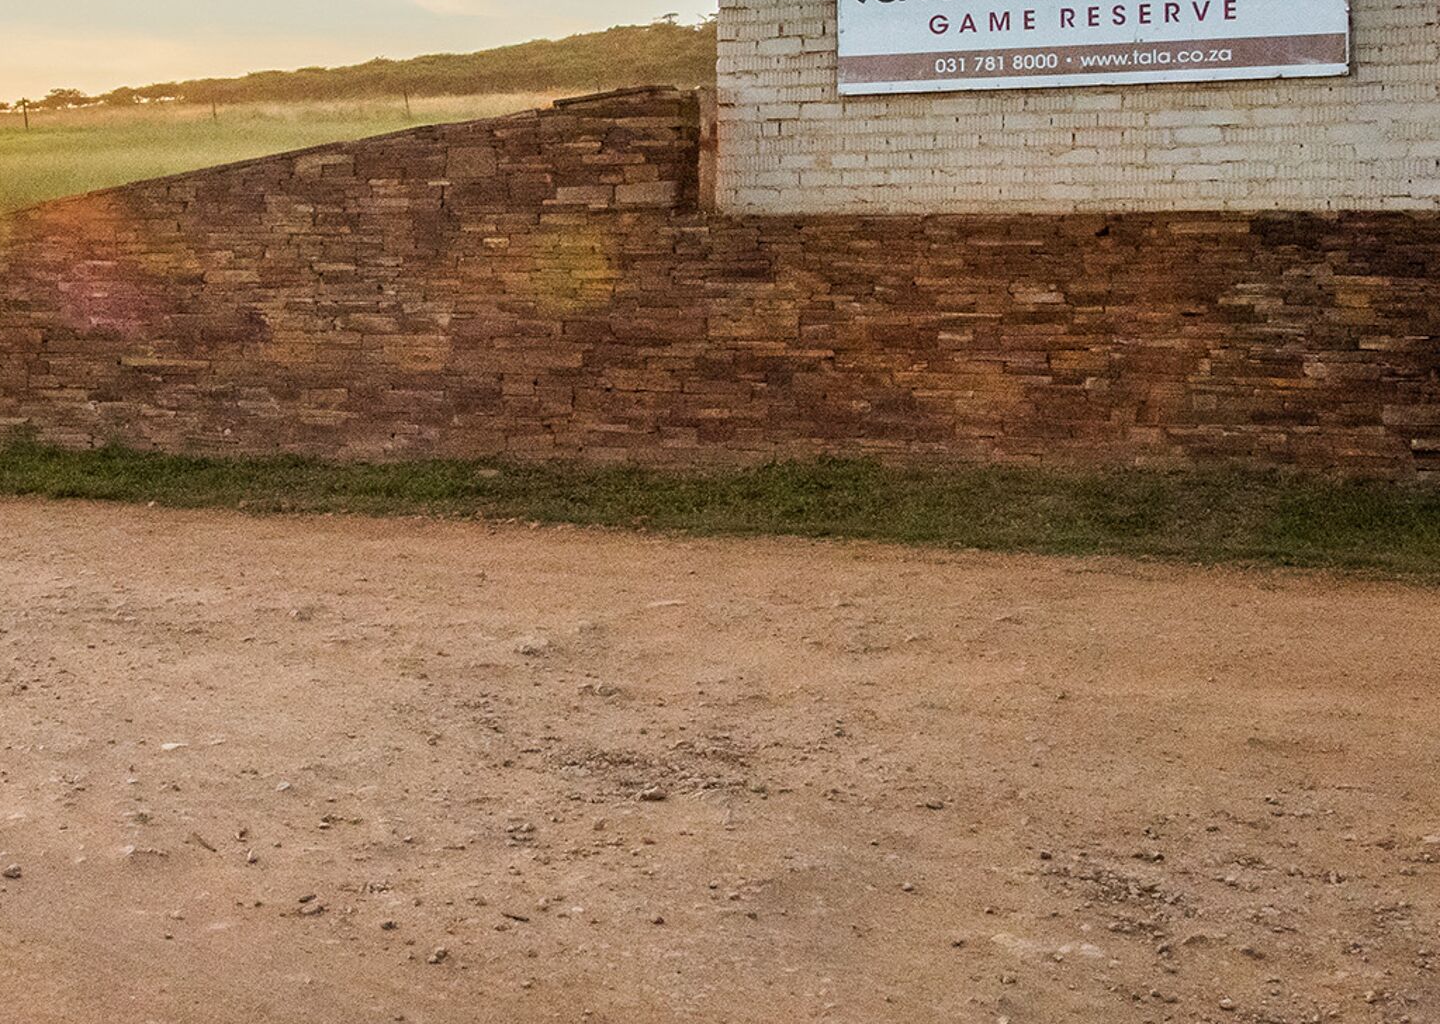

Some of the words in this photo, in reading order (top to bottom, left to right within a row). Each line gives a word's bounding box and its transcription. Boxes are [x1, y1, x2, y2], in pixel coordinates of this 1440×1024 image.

[928, 9, 1038, 35] GAME
[1059, 0, 1238, 29] RESERVE
[934, 57, 966, 74] 031
[972, 55, 1005, 72] 781
[1012, 53, 1058, 70] 8000
[1079, 47, 1233, 69] www.tala.co.za
